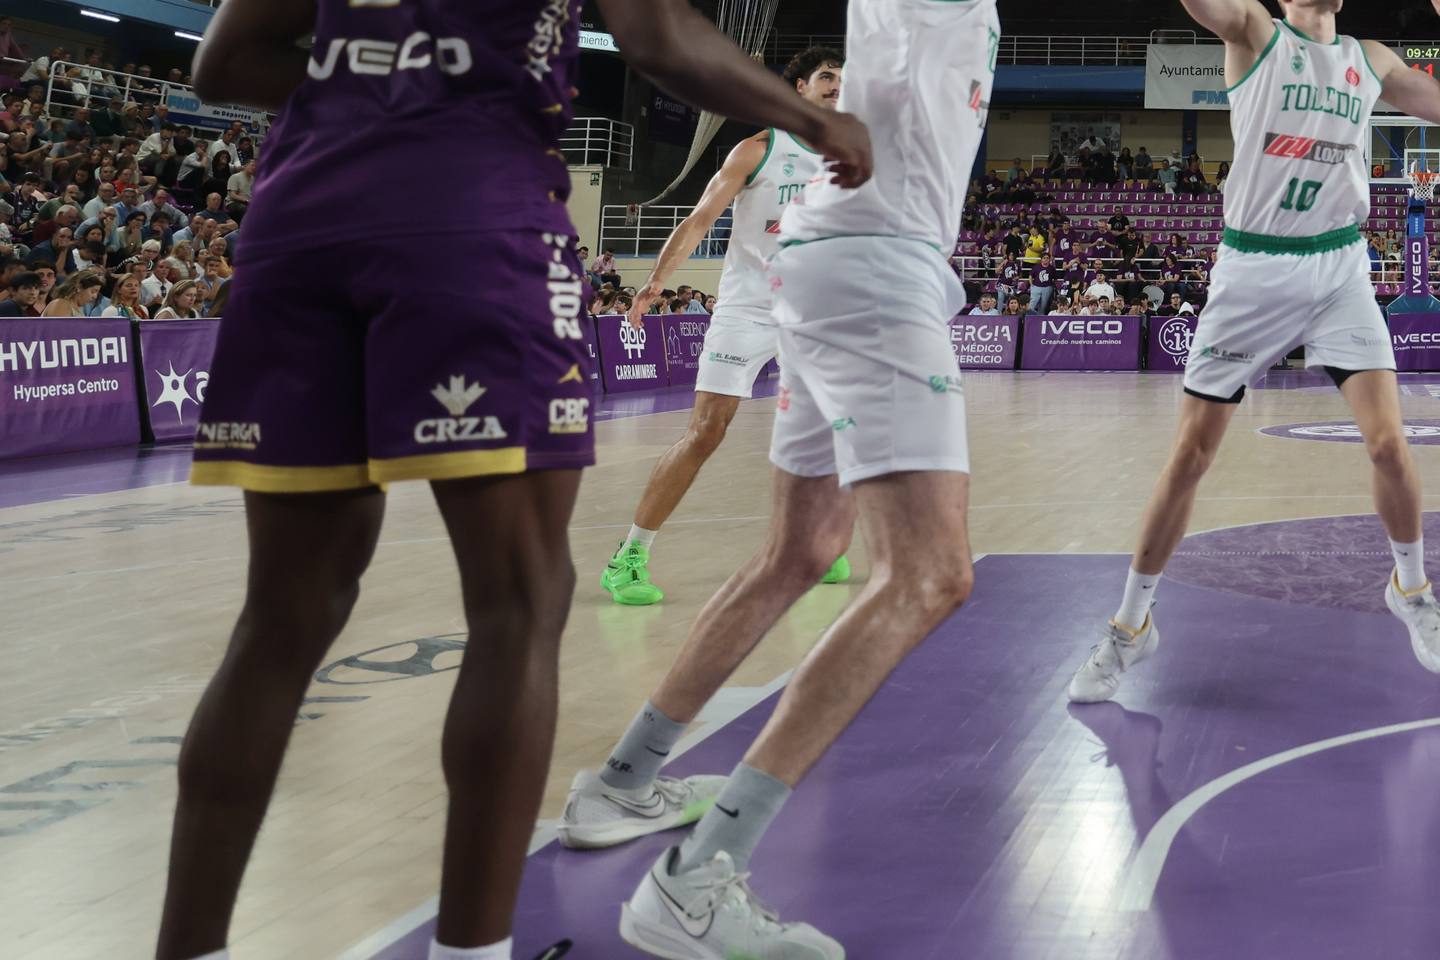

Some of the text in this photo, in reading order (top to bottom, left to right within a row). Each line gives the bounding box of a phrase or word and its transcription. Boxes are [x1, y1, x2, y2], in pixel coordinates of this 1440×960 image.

[1406, 48, 1440, 58] 09:47
[1160, 64, 1225, 78] Ayuntamie
[1282, 84, 1362, 125] TOLEDO
[1280, 176, 1324, 212] 10
[1412, 241, 1422, 294] IVECO
[1041, 320, 1123, 335] IVECO
[0, 336, 128, 372] HYUNDAI
[956, 354, 1002, 364] JERCICIO
[961, 343, 1003, 352] MÉDICO
[14, 376, 120, 402] Hyupersa Centro
[548, 398, 589, 426] CBC
[414, 416, 508, 444] CRZA
